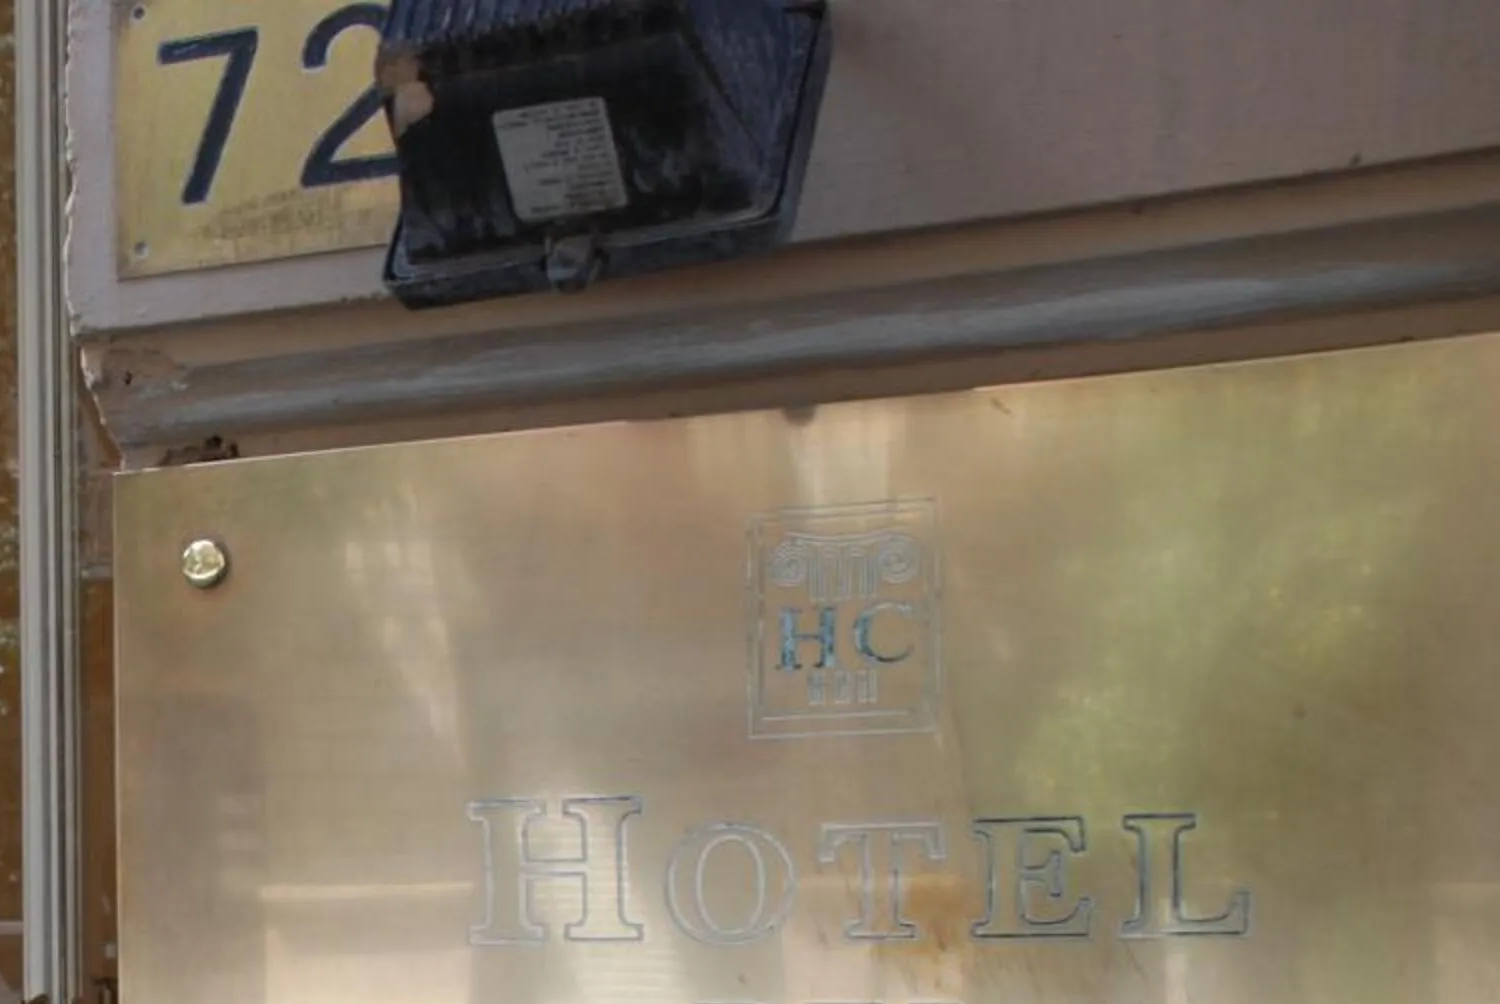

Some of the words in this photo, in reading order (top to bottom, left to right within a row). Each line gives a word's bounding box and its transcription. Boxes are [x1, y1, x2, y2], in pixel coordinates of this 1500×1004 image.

[156, 3, 401, 204] 72
[774, 602, 915, 669] HC
[468, 795, 1250, 946] HOTEL
